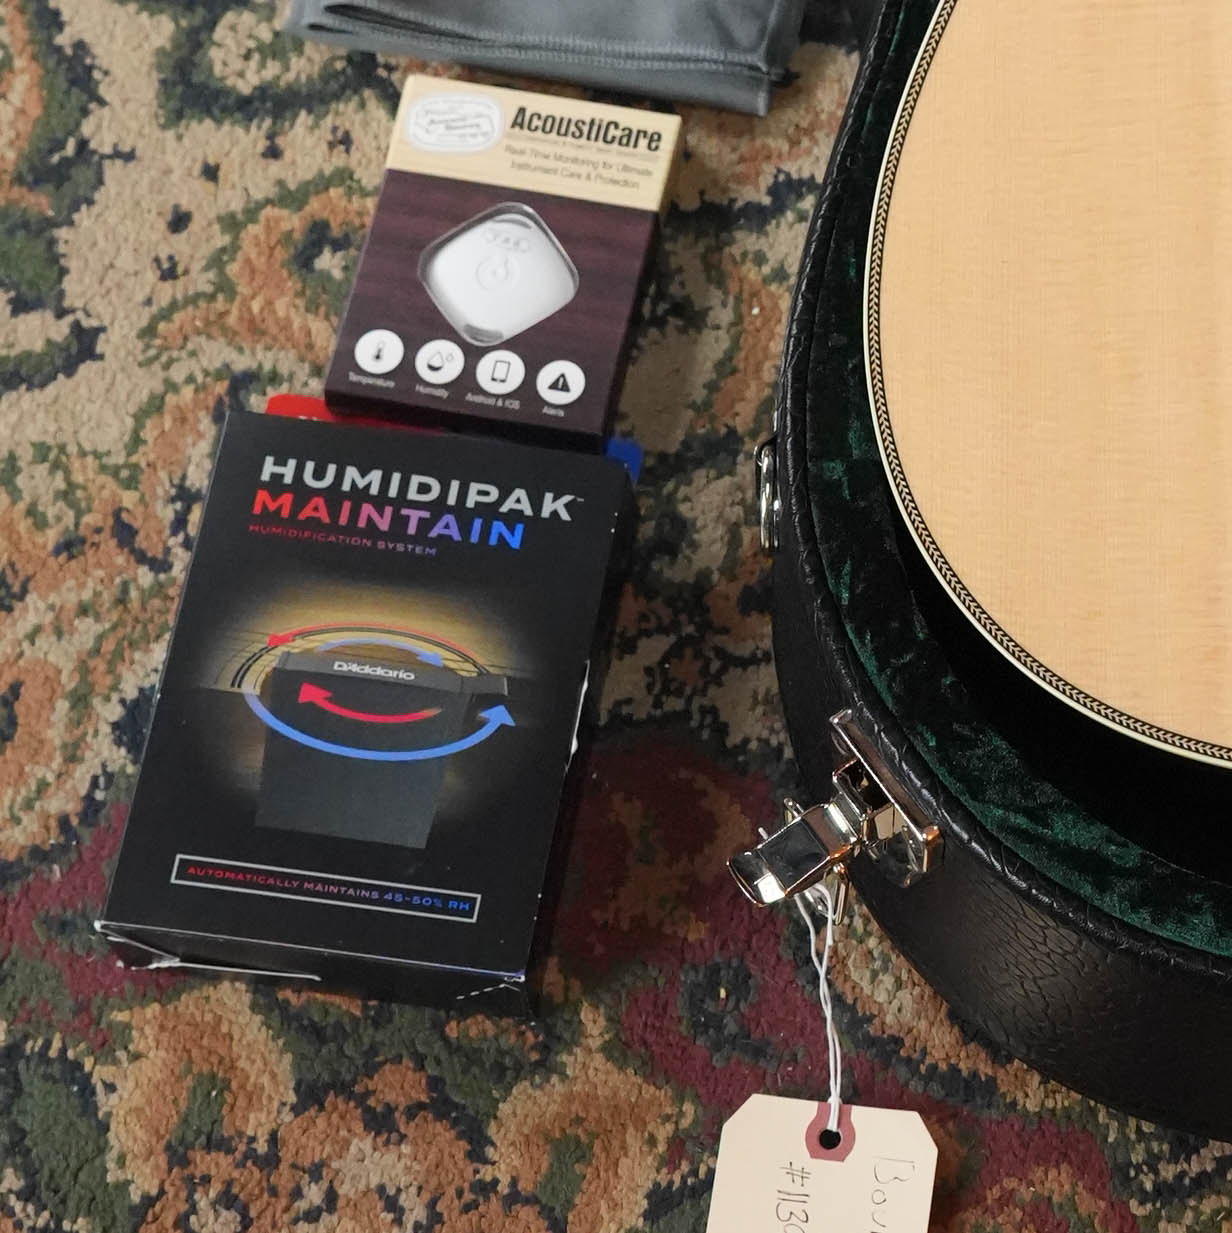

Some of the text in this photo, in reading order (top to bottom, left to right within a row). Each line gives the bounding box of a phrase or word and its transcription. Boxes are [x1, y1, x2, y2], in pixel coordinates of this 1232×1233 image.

[510, 106, 662, 152] AcoustiCare
[260, 455, 577, 522] HUMIDIPAK
[248, 523, 437, 556] HUMIDIFICATION SYSTEM
[252, 489, 526, 550] MAINTAIN
[187, 865, 470, 911] AUTOMATICALLY MAINTAINS 45-50% RH
